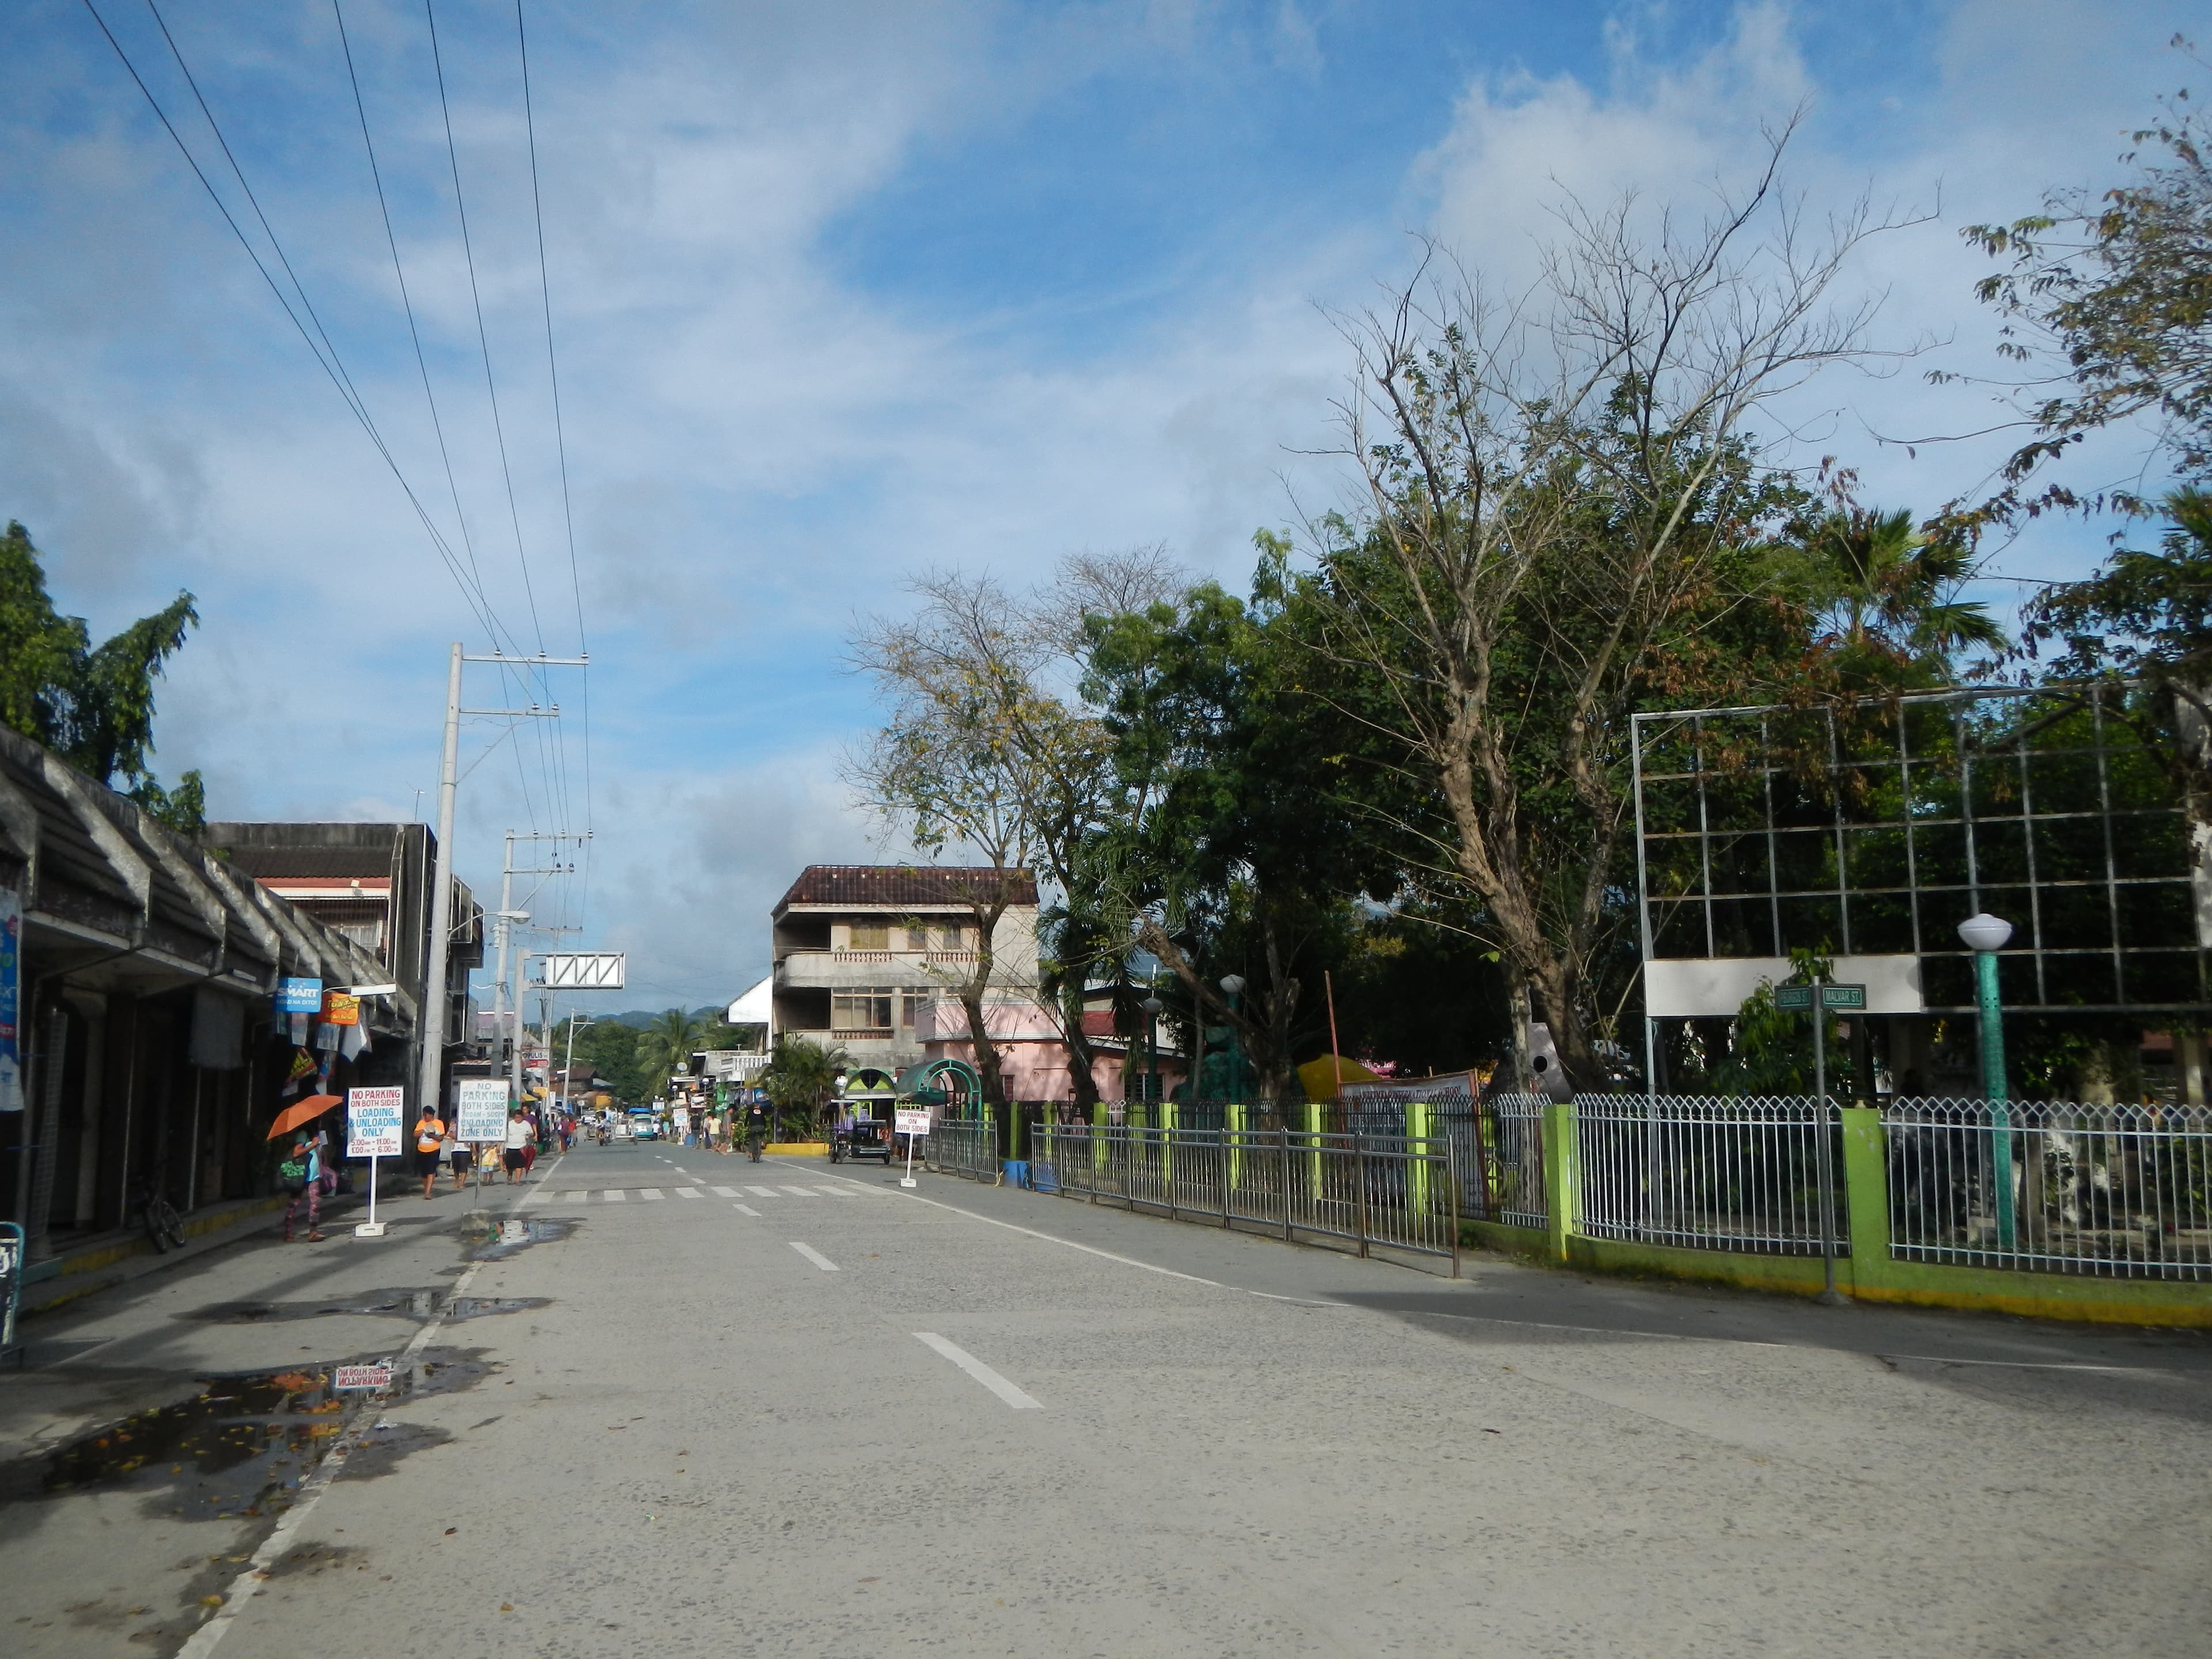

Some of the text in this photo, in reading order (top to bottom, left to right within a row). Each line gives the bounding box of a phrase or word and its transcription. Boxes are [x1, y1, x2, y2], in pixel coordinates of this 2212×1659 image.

[277, 987, 319, 997] SMART
[1825, 990, 1850, 1002] MALVAR
[352, 1089, 400, 1099] NO PARKING
[463, 1091, 505, 1100] PARKING
[462, 1102, 505, 1110] BOTH SIDES
[358, 1108, 394, 1118] LOADING
[349, 1118, 402, 1127] & UNLOADING
[461, 1119, 503, 1127] UNLOADING
[362, 1127, 384, 1137] ONLY
[461, 1128, 503, 1137] ZONE ONLY
